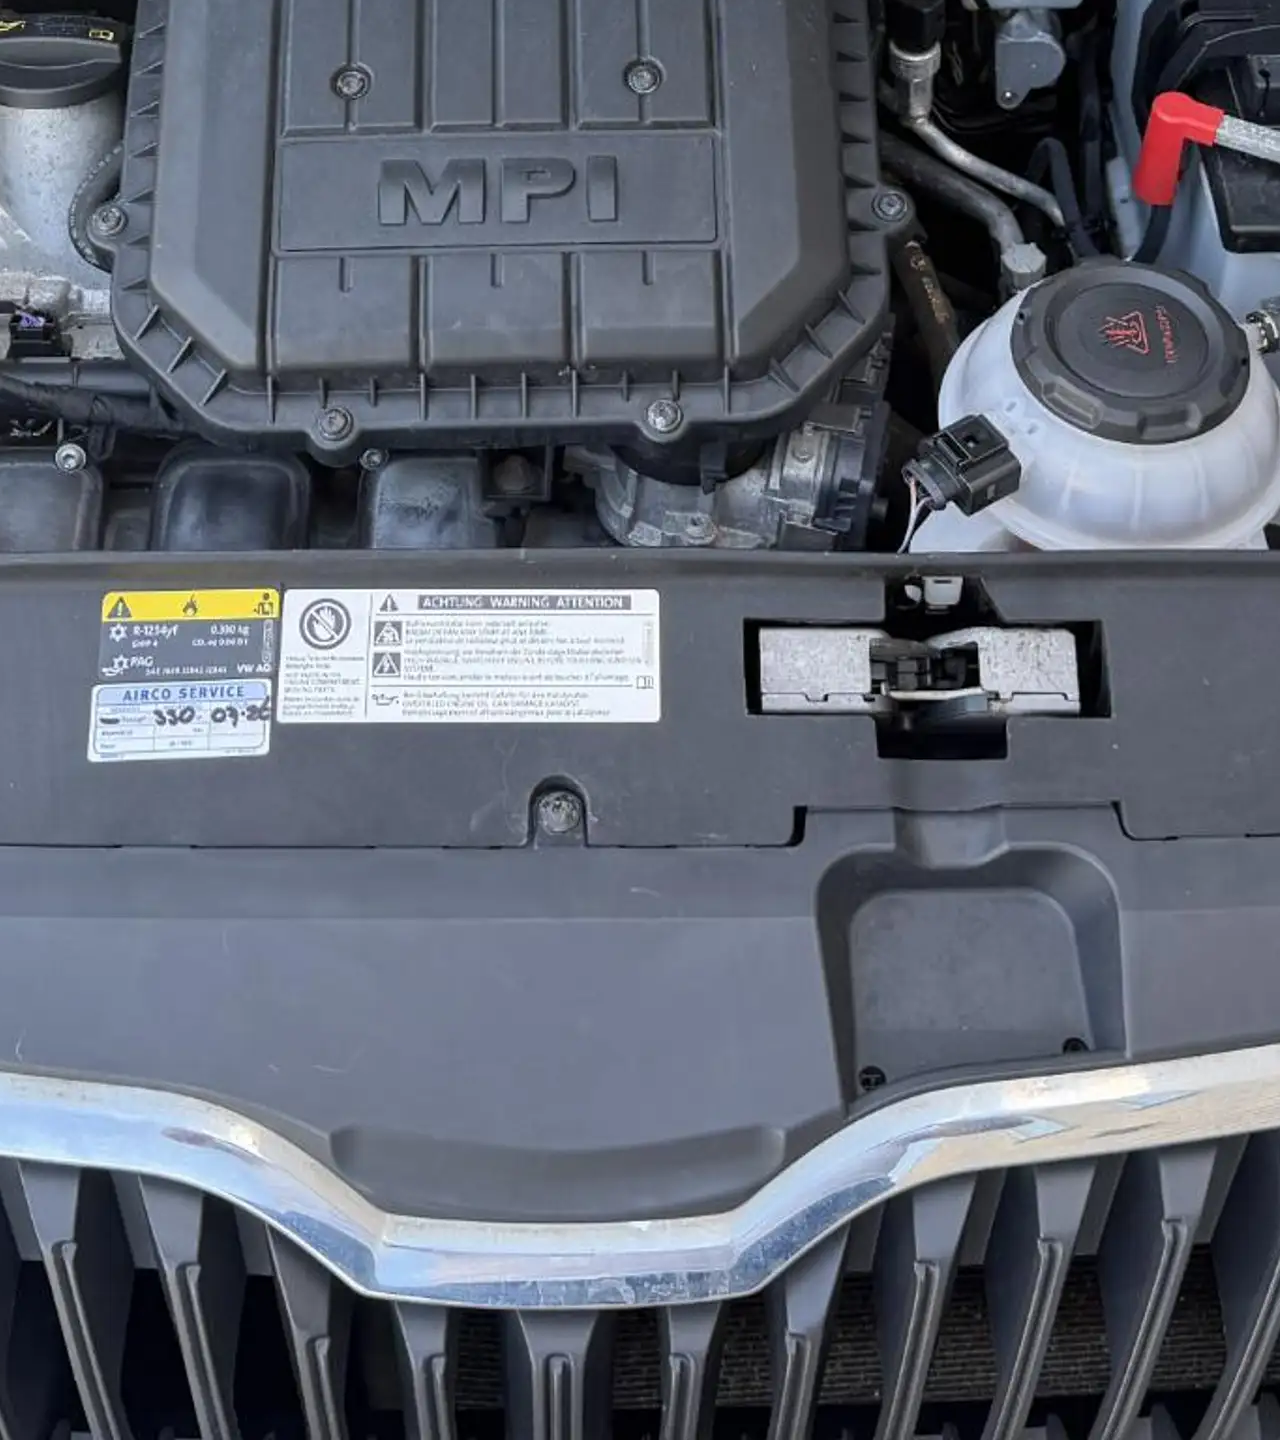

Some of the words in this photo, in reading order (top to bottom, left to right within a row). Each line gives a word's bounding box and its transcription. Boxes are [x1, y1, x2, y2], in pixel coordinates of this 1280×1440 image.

[377, 155, 620, 227] MPI
[422, 596, 483, 608] ACHTUNG
[489, 596, 551, 608] WARNING
[556, 596, 624, 608] ATTENTION
[129, 656, 154, 668] PAG
[122, 688, 172, 702] AIRCO
[178, 686, 245, 700] SERVICE
